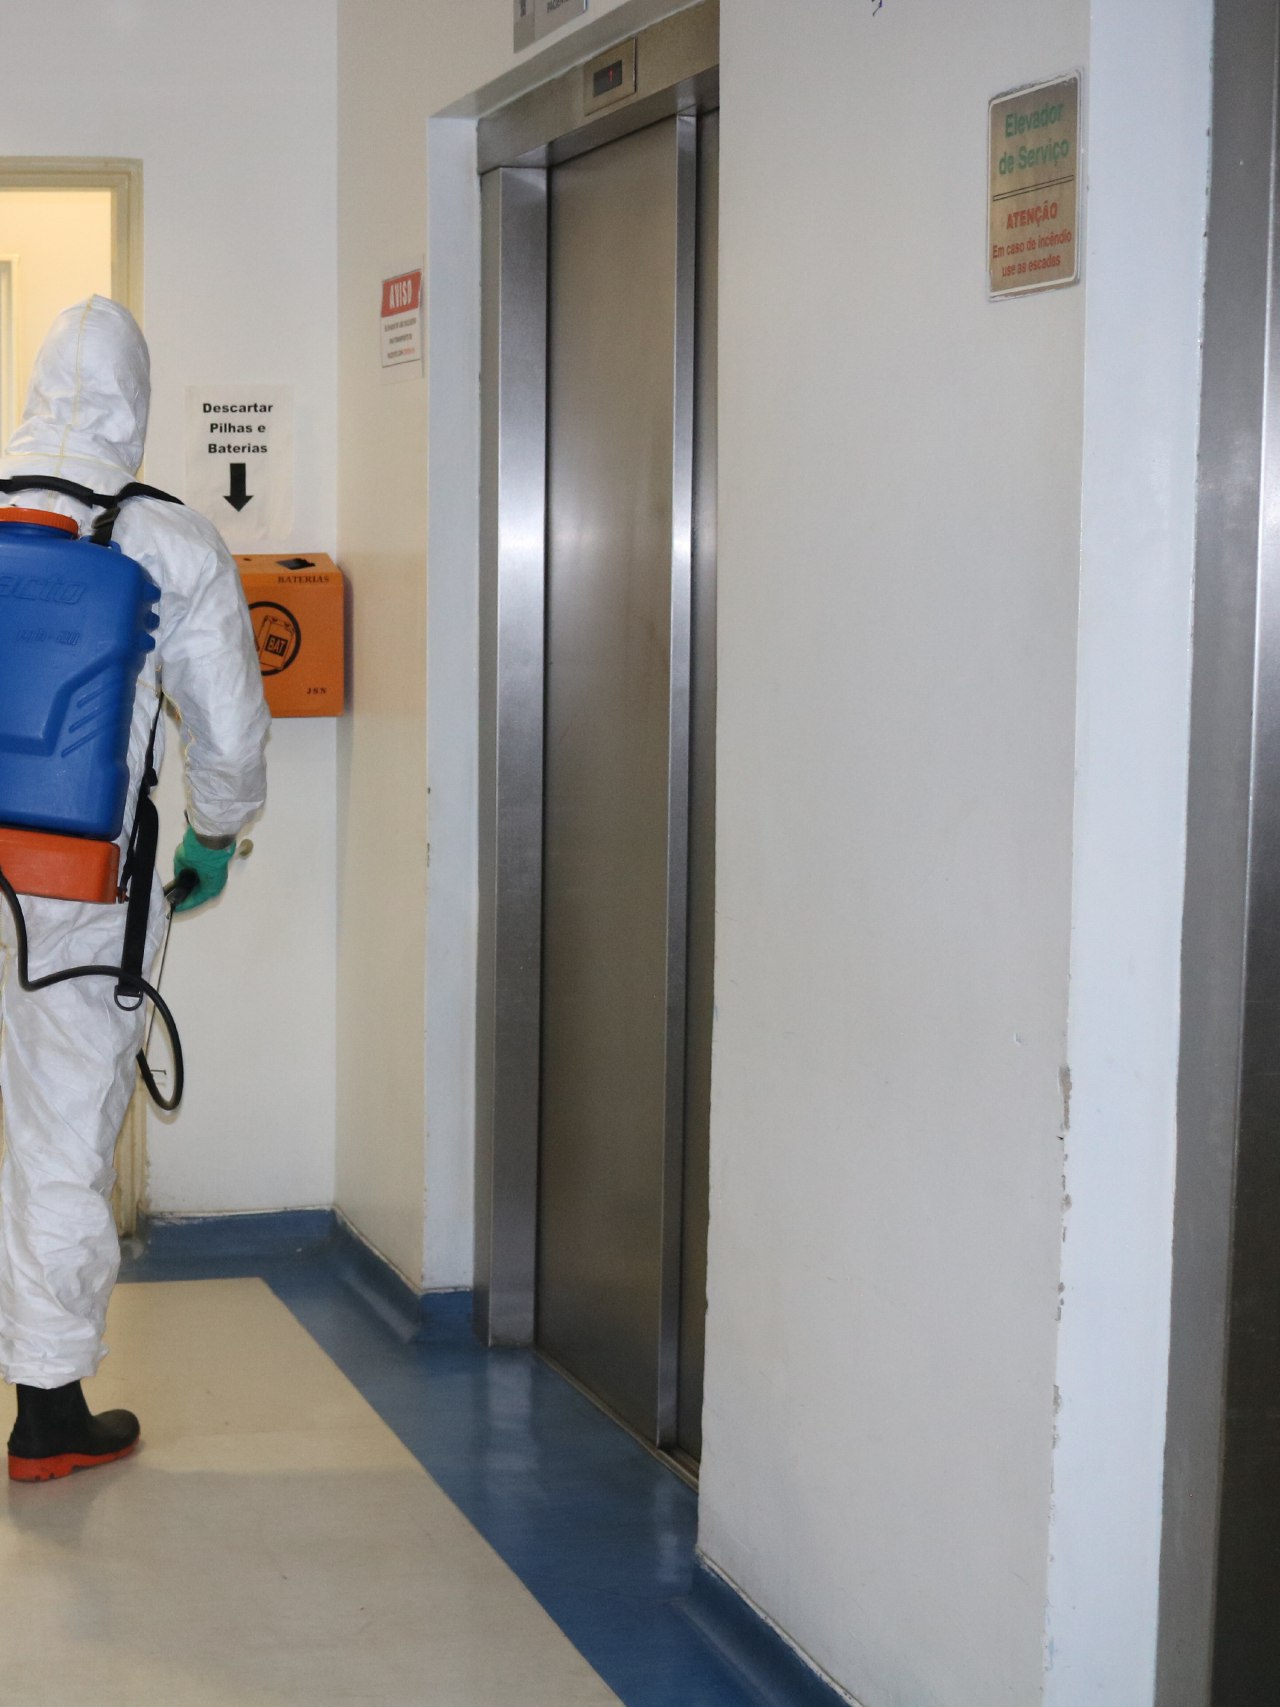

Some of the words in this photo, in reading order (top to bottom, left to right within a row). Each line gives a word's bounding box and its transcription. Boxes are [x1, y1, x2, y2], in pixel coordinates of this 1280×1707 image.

[1005, 101, 1064, 138] Elevador
[998, 153, 1015, 176] de
[1017, 137, 1071, 171] Serviço
[1006, 199, 1058, 231] ATENÇÃO
[992, 244, 1004, 259] Em
[1006, 240, 1025, 256] caso
[1026, 236, 1036, 252] de
[1038, 230, 1072, 249] incêndio
[1002, 263, 1016, 277] use
[1017, 261, 1027, 275] as
[1028, 253, 1061, 273] escadas
[389, 279, 412, 309] AVISO
[202, 403, 274, 413] Descartar
[210, 422, 253, 434] Pilhas
[257, 424, 266, 433] e
[208, 443, 268, 454] Baterias
[278, 575, 330, 584] BATERIAS
[268, 637, 286, 655] BAT
